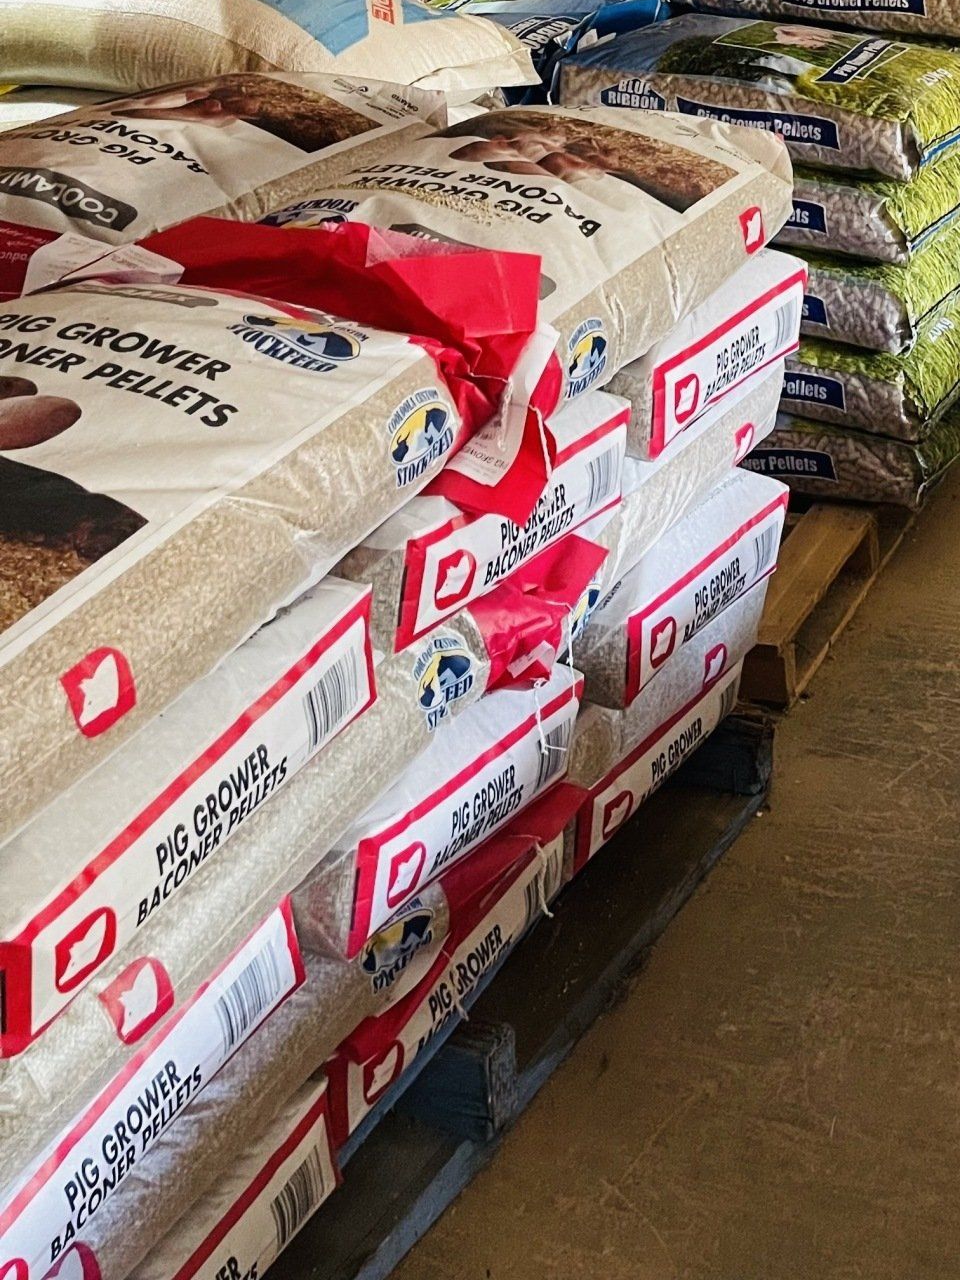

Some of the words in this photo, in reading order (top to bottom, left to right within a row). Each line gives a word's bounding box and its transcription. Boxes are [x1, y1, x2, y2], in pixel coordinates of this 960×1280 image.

[608, 93, 659, 110] RIBBON
[617, 80, 651, 95] BLUE
[99, 142, 156, 165] PIG
[720, 114, 772, 131] Grower
[774, 118, 822, 141] Pellets
[460, 173, 602, 238] BACONER
[494, 198, 553, 224] PIG
[0, 313, 56, 333] PIG
[57, 322, 232, 381] GROWER
[225, 323, 339, 373] STOCKFEED
[704, 361, 740, 404] BACONER
[739, 342, 766, 374] PELLETS
[716, 347, 728, 376] PIG
[731, 325, 760, 365] GROWER
[82, 363, 239, 428] PELLETS
[782, 380, 827, 400] Pellets
[395, 428, 454, 488] STOCKFEED
[741, 456, 767, 471] wer
[768, 456, 818, 472] Pellets
[483, 530, 538, 587] BACONER
[537, 504, 576, 549] PELLETS
[500, 518, 519, 551] PIG
[694, 585, 708, 614] PIG
[709, 556, 741, 601] GROWER
[652, 752, 667, 782] PIG
[668, 717, 703, 766] GROWER
[156, 823, 189, 877] PIG
[193, 743, 270, 840] GROWER
[428, 817, 482, 877] BACONER
[482, 783, 525, 837] PELLETS
[451, 803, 470, 838] PIG
[473, 764, 516, 817] GROWER
[136, 823, 224, 928] BACONER
[226, 756, 288, 838] PELLETS
[428, 982, 451, 1022] PIG
[452, 923, 503, 996] GROWER
[50, 1145, 137, 1264] BACONER
[141, 1065, 204, 1154] PELLETS
[63, 1157, 101, 1213] PIG
[101, 1059, 182, 1166] GROWER
